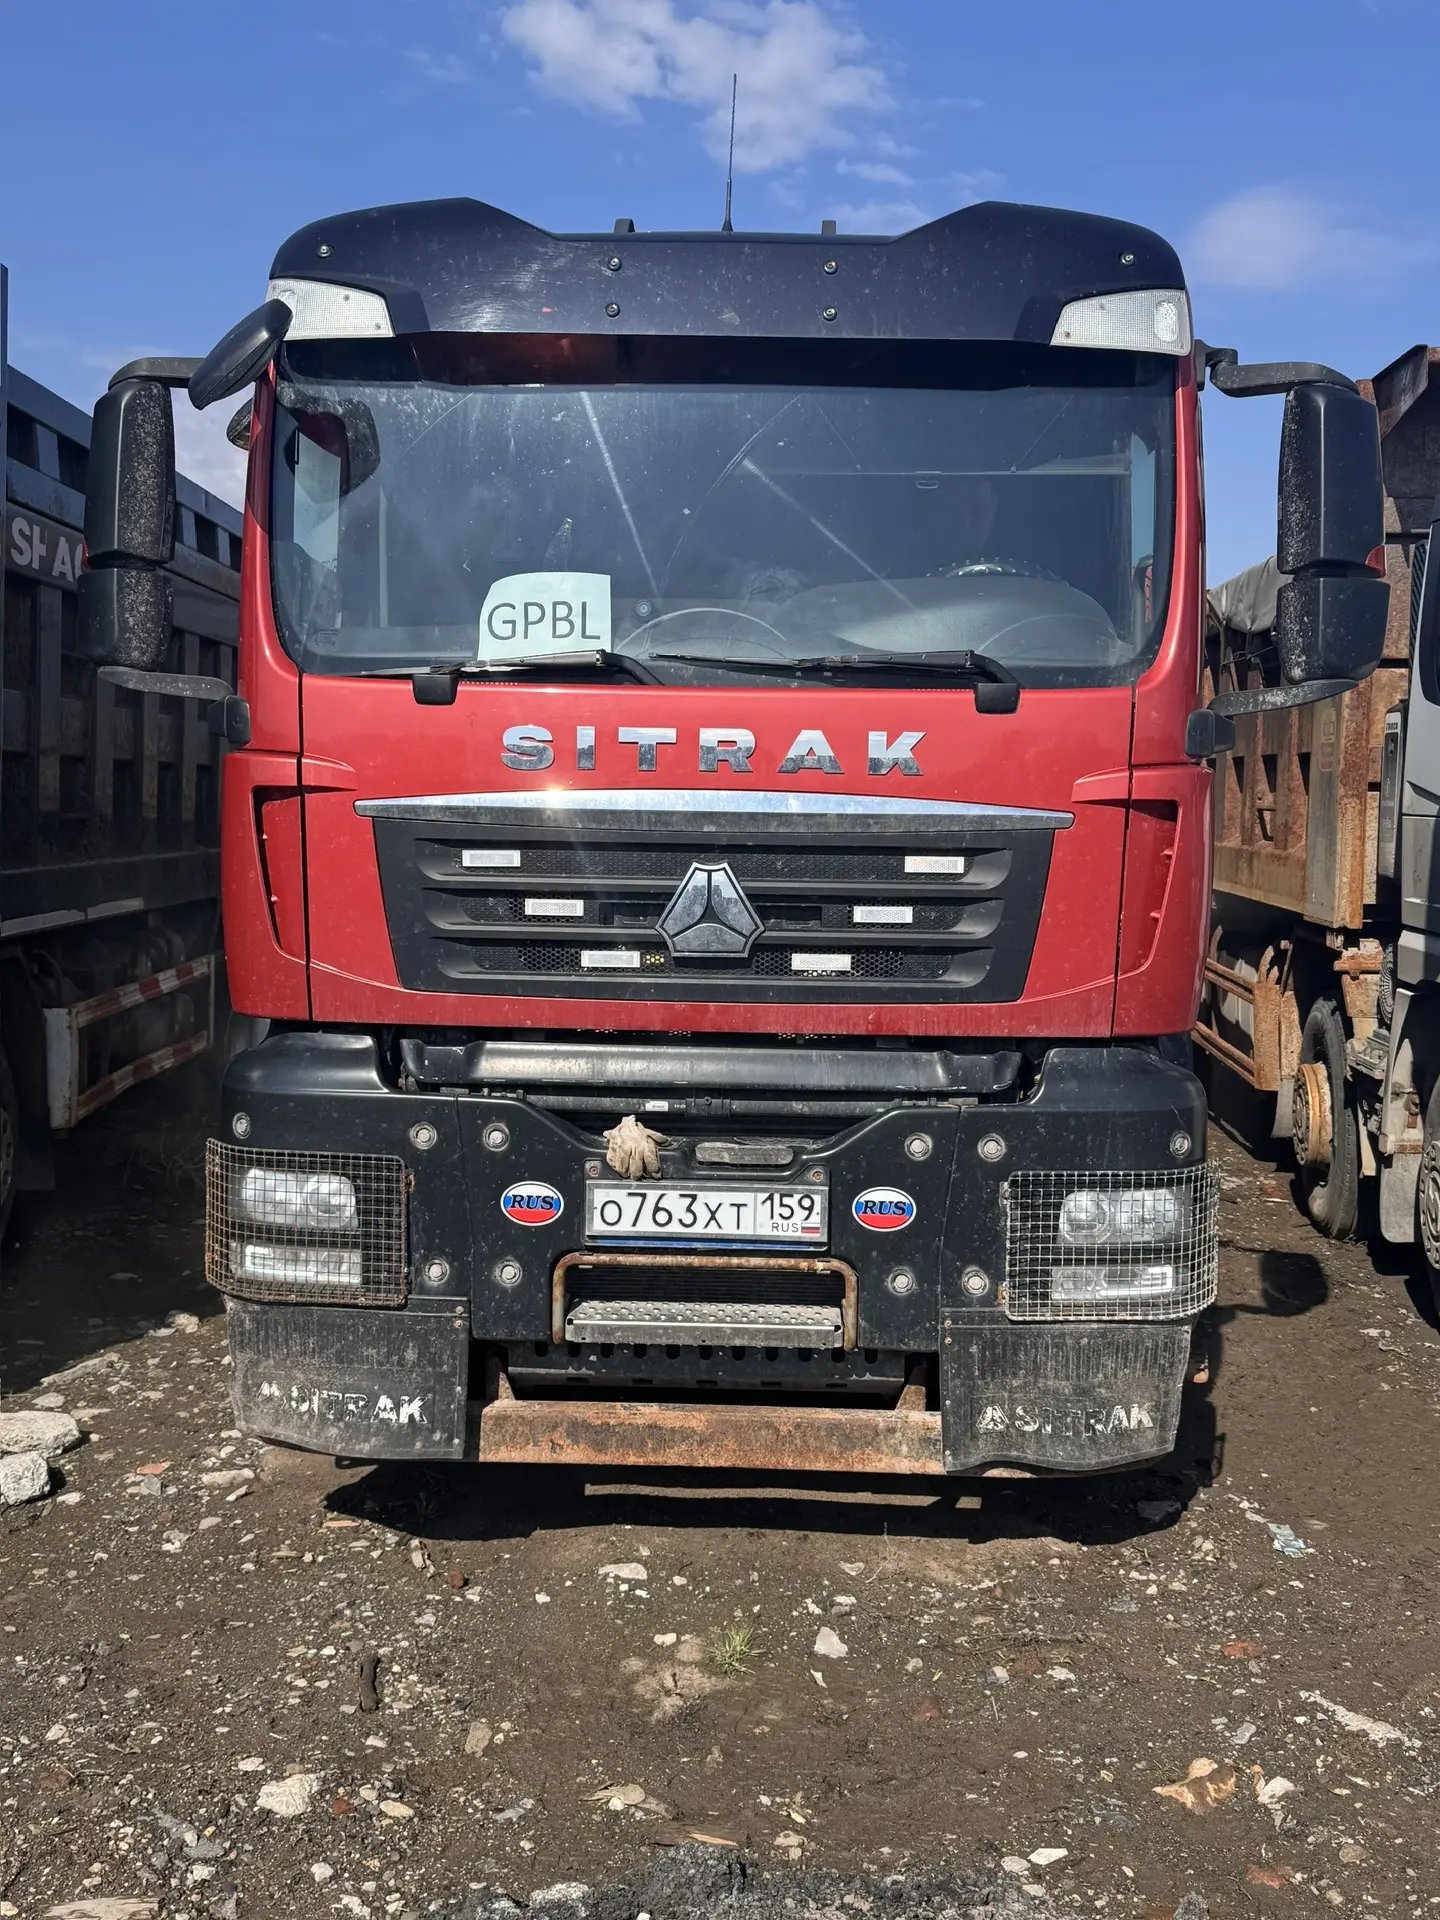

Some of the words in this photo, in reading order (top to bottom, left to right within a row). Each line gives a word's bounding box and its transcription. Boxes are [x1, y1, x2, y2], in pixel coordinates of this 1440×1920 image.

[487, 599, 601, 641] GPBL
[501, 724, 927, 776] SITRAK
[508, 1193, 556, 1211] RUS
[760, 1192, 817, 1222] 159
[860, 1199, 909, 1216] RUS
[771, 1221, 800, 1234] RUS
